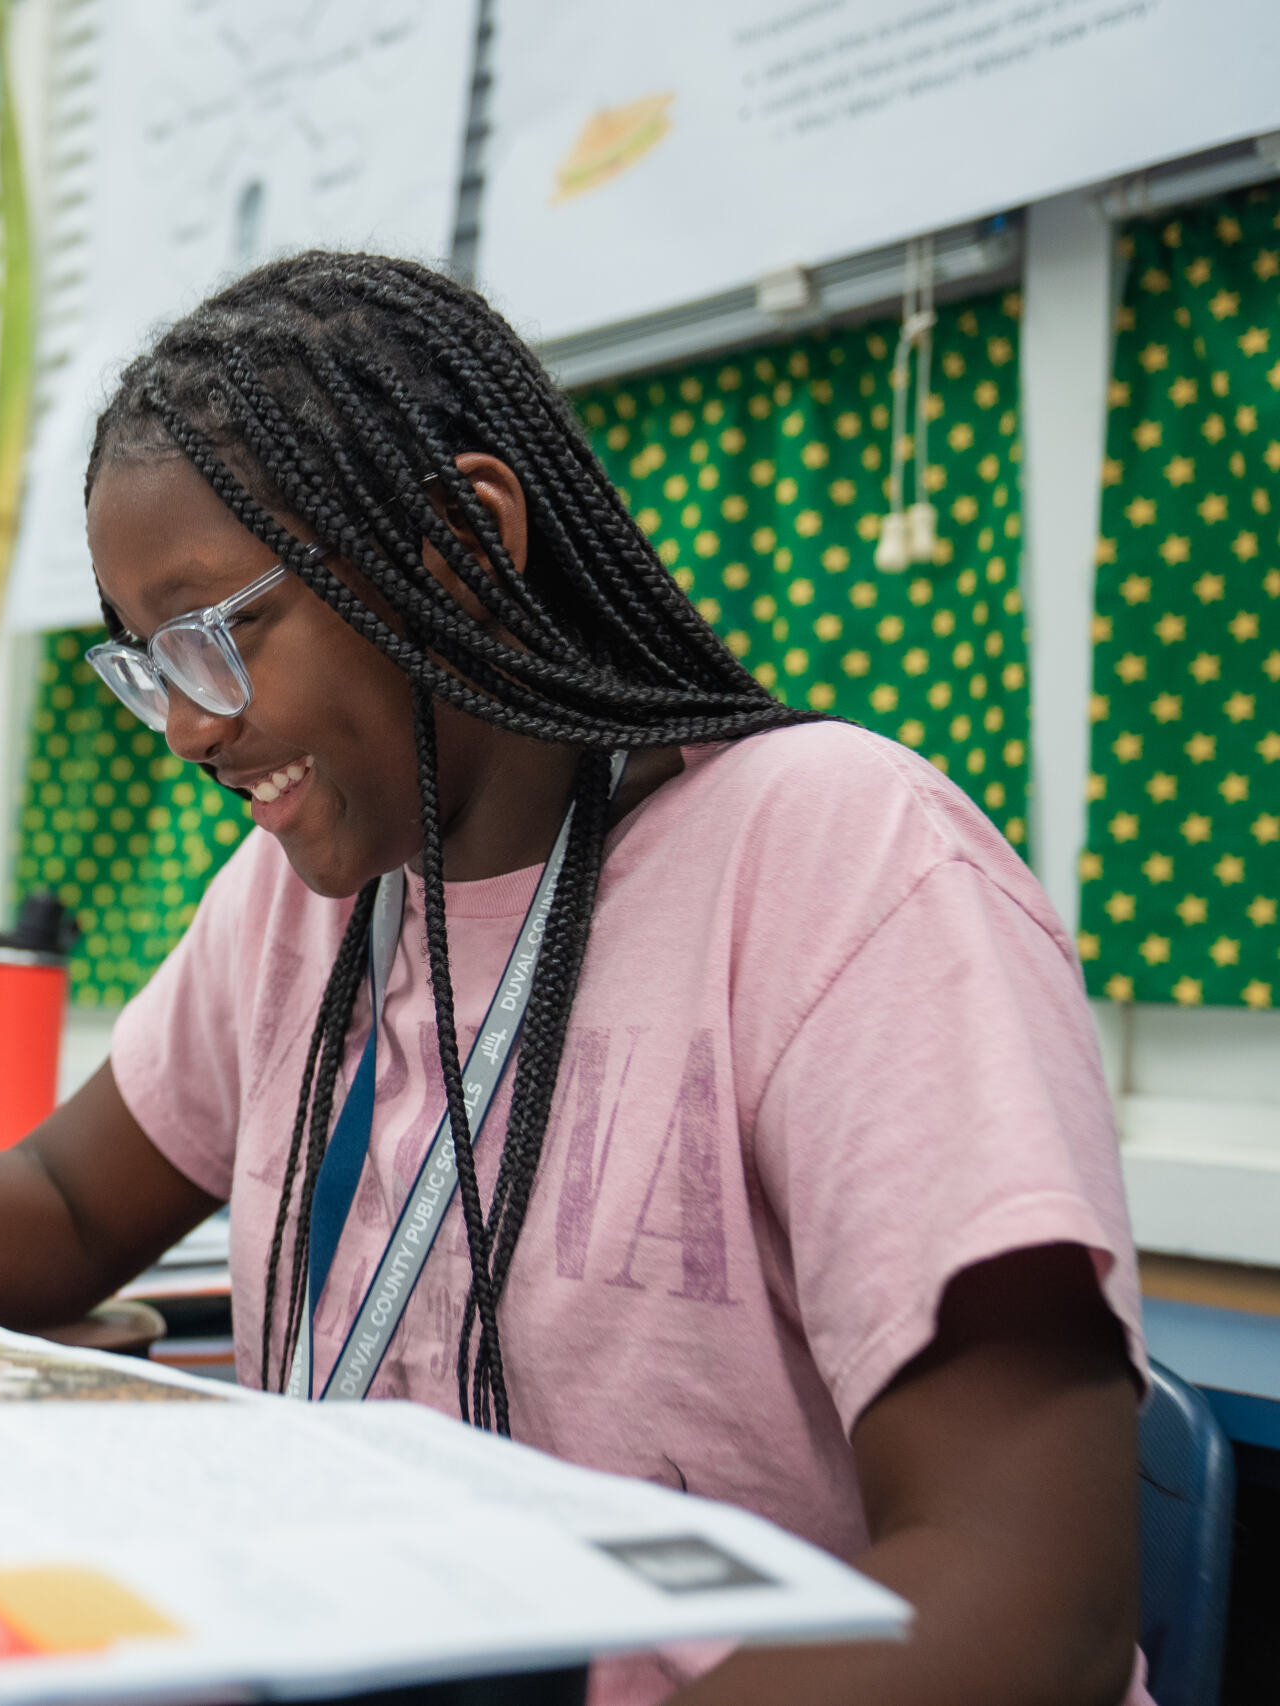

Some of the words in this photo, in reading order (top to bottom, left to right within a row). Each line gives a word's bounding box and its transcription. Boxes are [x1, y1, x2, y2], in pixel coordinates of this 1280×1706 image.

[500, 950, 537, 1012] DUVAL
[340, 1331, 380, 1397] DUVAL
[370, 1243, 416, 1327] COUNTY
[405, 1172, 446, 1245] PUBLIC
[435, 1081, 483, 1172] SCLS
